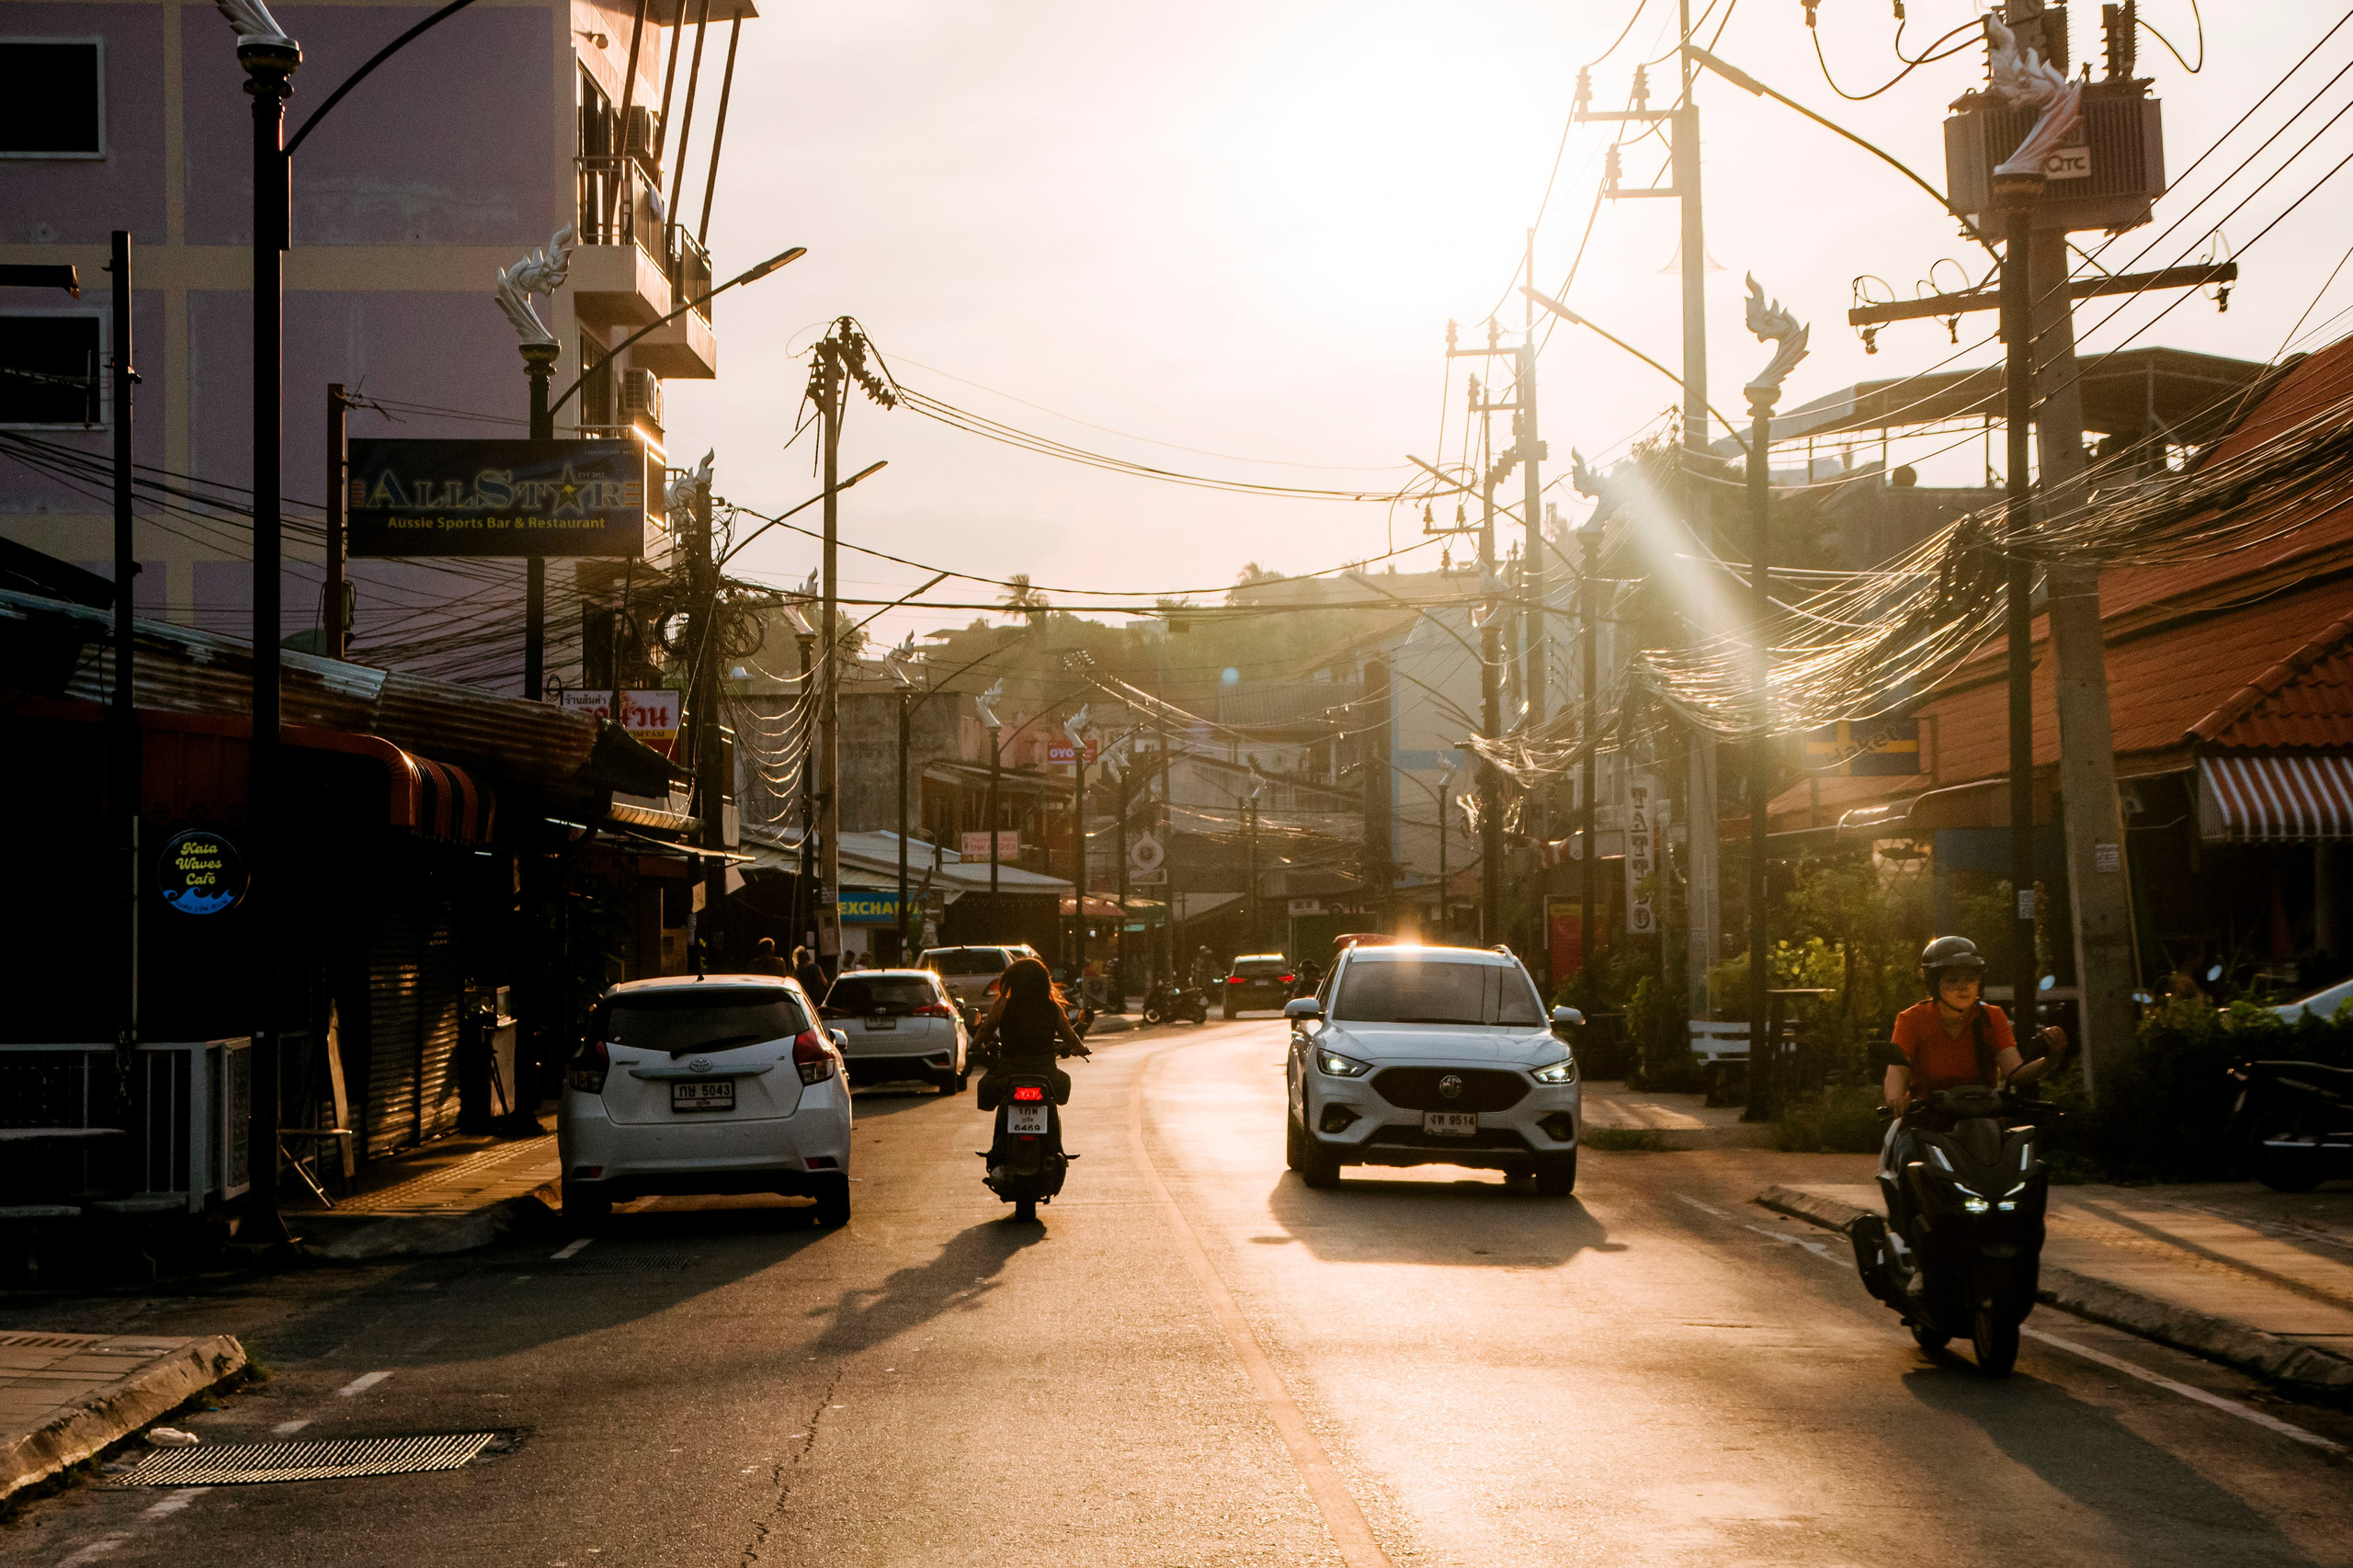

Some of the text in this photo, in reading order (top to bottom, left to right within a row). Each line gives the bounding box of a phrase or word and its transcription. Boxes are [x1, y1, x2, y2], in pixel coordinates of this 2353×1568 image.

[2046, 154, 2086, 173] QTC
[387, 517, 605, 531] Aussie Sports Bar & Restaurant
[1049, 747, 1074, 758] OYO
[180, 842, 219, 856] Kata
[176, 857, 222, 870] Waves
[701, 1084, 731, 1096] 5043
